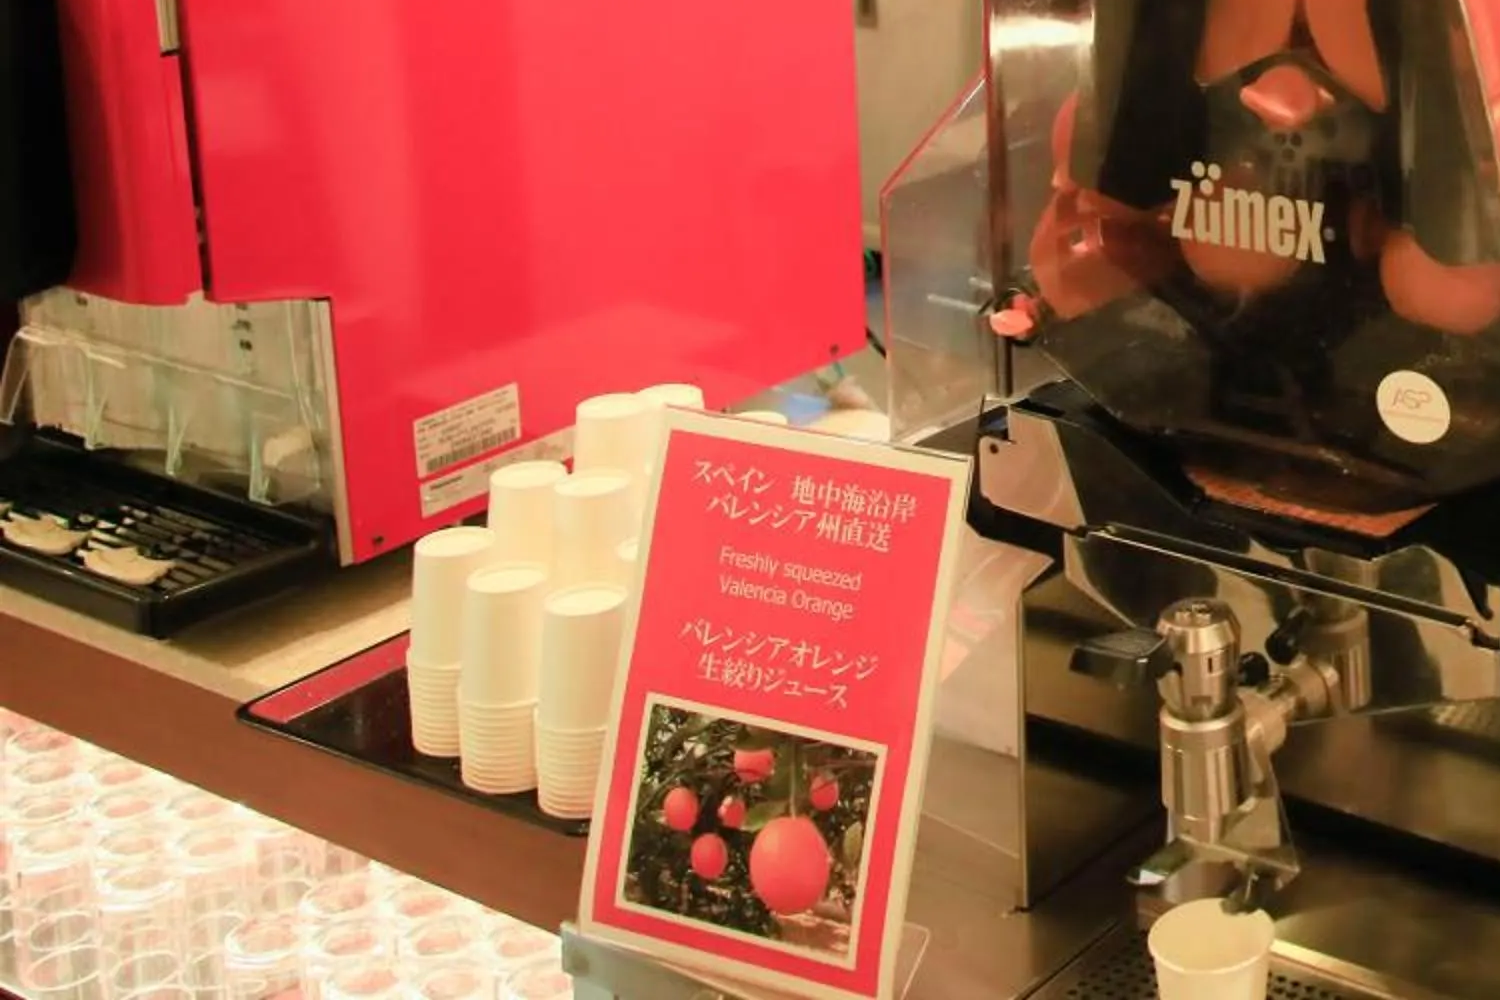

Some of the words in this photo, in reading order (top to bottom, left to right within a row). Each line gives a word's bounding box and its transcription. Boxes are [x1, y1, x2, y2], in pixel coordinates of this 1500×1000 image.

[693, 461, 775, 493] スペイン
[792, 475, 916, 523] 地中海沿岸
[707, 494, 892, 552] バレンシア州直送
[719, 545, 780, 580] Freshly
[783, 562, 862, 592] squeezed
[718, 574, 786, 606] Valencia
[791, 592, 854, 621] Orange
[680, 619, 878, 680] バレンシアオレンジ
[699, 652, 847, 708] 生絞りジュース
